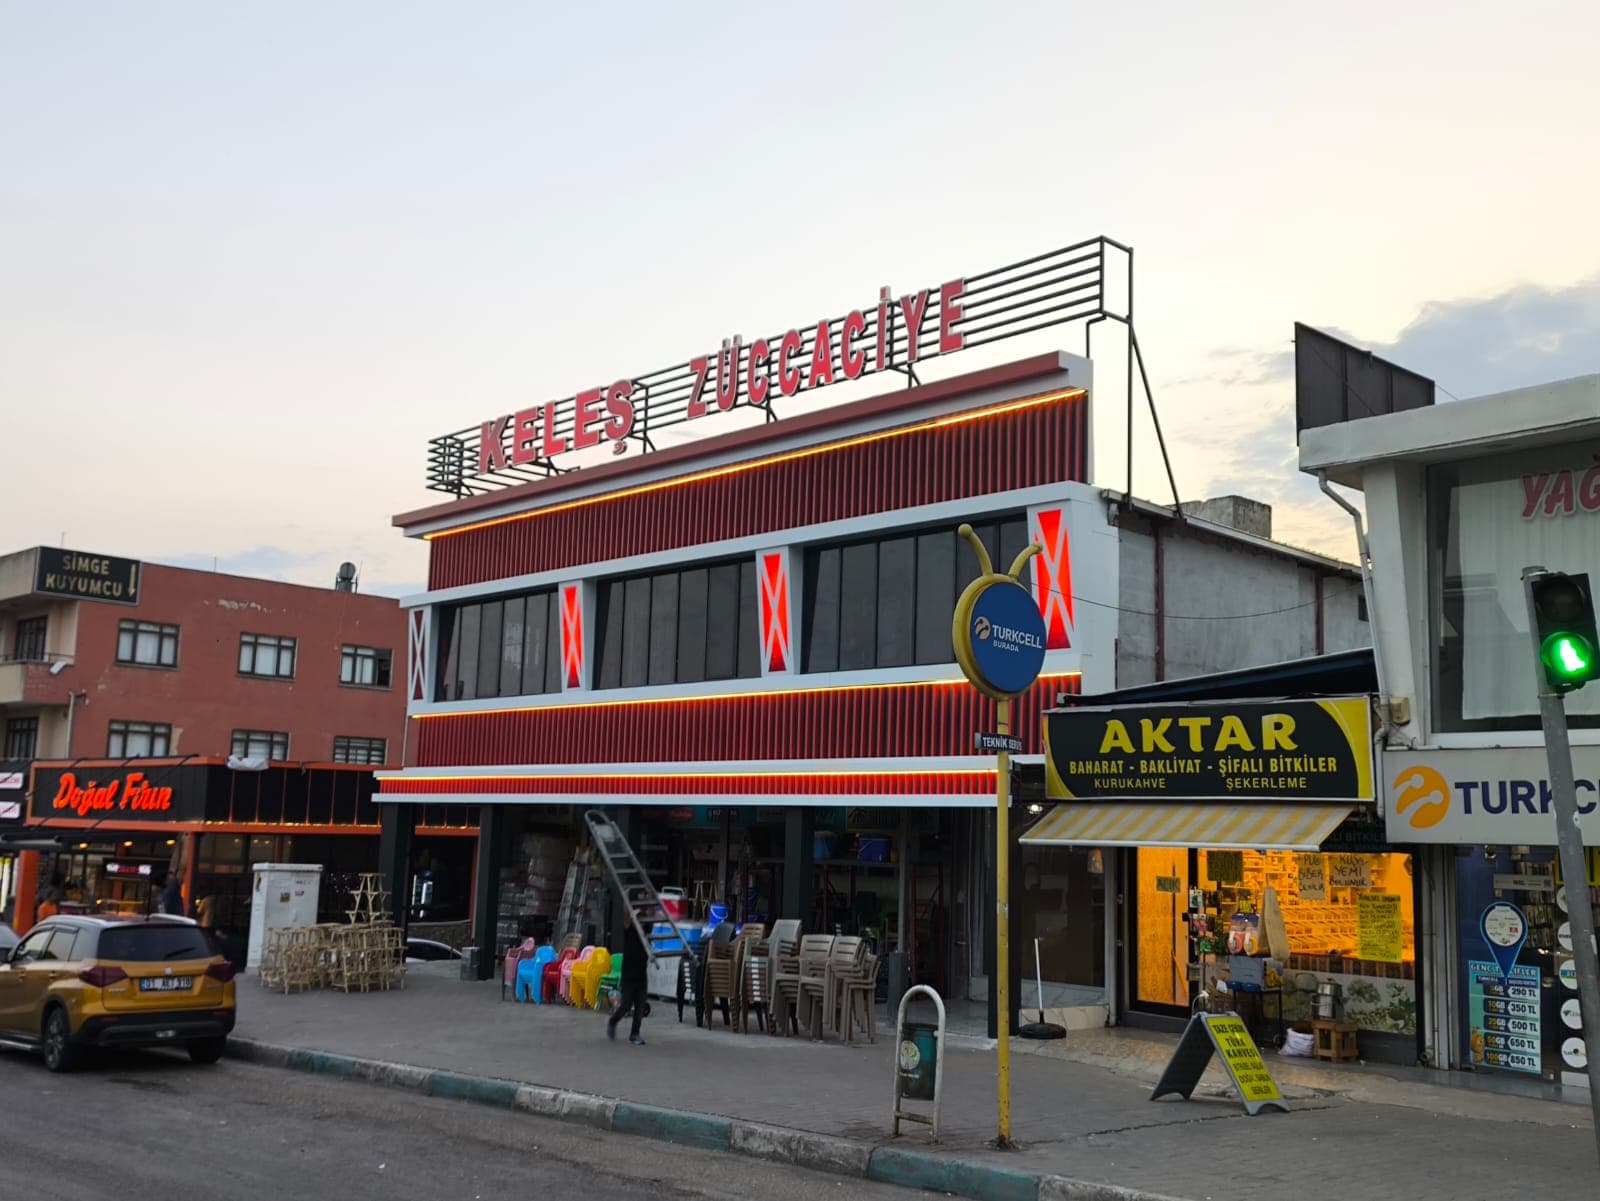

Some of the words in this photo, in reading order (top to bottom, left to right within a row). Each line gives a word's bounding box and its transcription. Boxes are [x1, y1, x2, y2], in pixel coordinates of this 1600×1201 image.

[478, 379, 634, 475] KELEŞ
[687, 277, 965, 419] ZÜCCACİYE
[62, 551, 110, 576] SİMGE
[45, 572, 122, 597] KUYUMCU
[992, 624, 1043, 649] TURKCELL
[993, 639, 1019, 653] BURADA
[982, 735, 1008, 748] TEKNİK
[1099, 713, 1298, 753] AKTAR
[1070, 759, 1124, 775] BAHARAT
[1140, 755, 1201, 774] BAKLİYAT
[1219, 755, 1263, 778] ŞİFALI
[1270, 754, 1337, 773] BİTKİLER
[1094, 777, 1166, 789] KURUKAHVE
[1226, 777, 1307, 791] ŞEKERLEME
[53, 772, 120, 817] Doğal
[1454, 779, 1600, 815] TURKC
[1528, 989, 1537, 998] TL
[1510, 1003, 1527, 1012] 350
[1528, 1005, 1537, 1015] TL
[1511, 1020, 1528, 1030] 500
[1529, 1022, 1538, 1032] TL
[1510, 1038, 1526, 1048] 650
[1527, 1040, 1536, 1050] TL
[1527, 1057, 1537, 1067] TL
